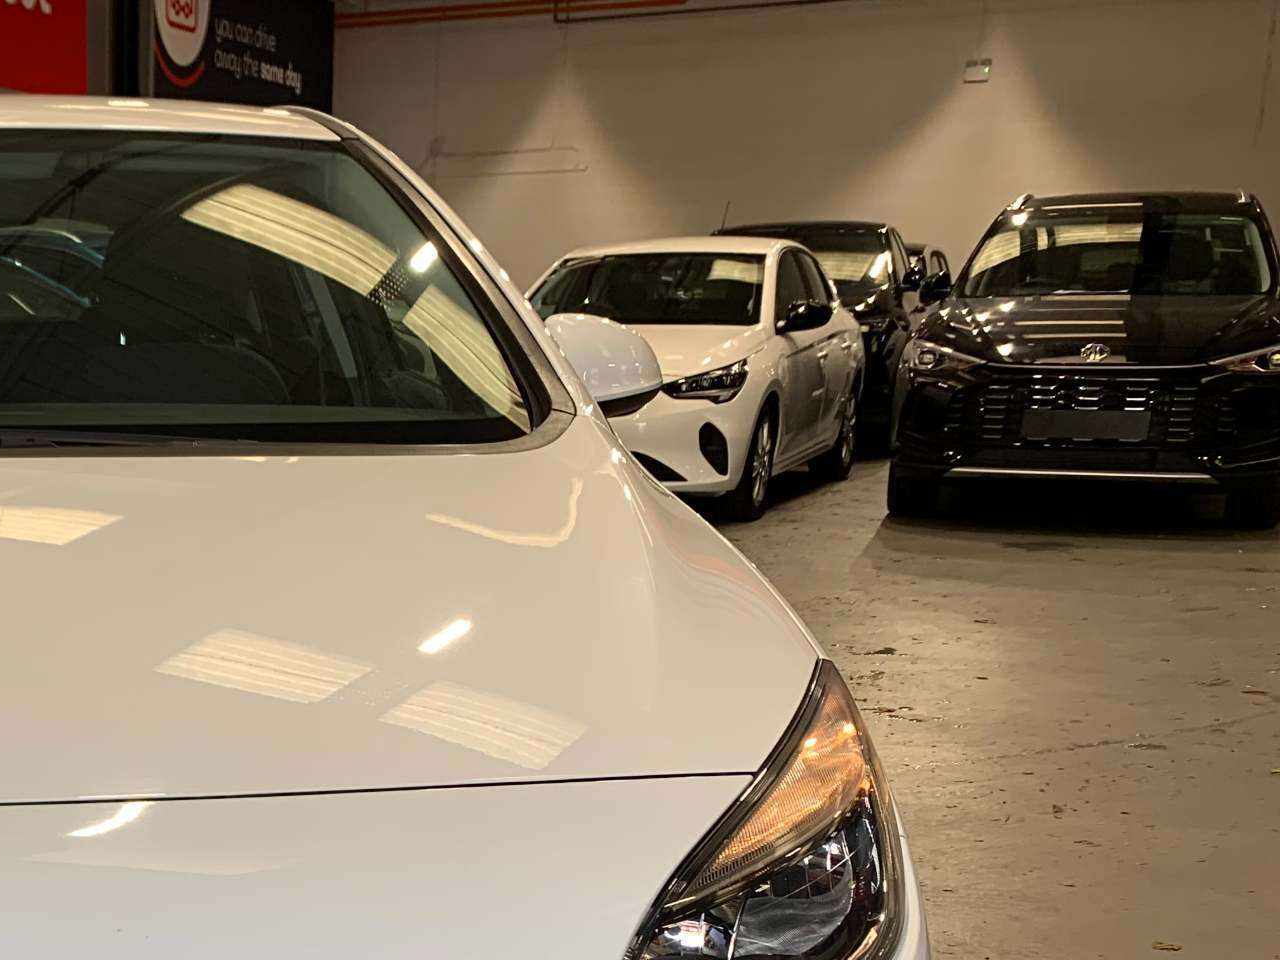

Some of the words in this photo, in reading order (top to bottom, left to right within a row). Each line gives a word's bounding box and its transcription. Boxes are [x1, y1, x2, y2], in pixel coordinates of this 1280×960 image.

[214, 18, 233, 43] you
[235, 24, 254, 46] can
[214, 49, 241, 79] away
[243, 49, 259, 78] the
[261, 61, 283, 84] same
[285, 61, 302, 95] day
